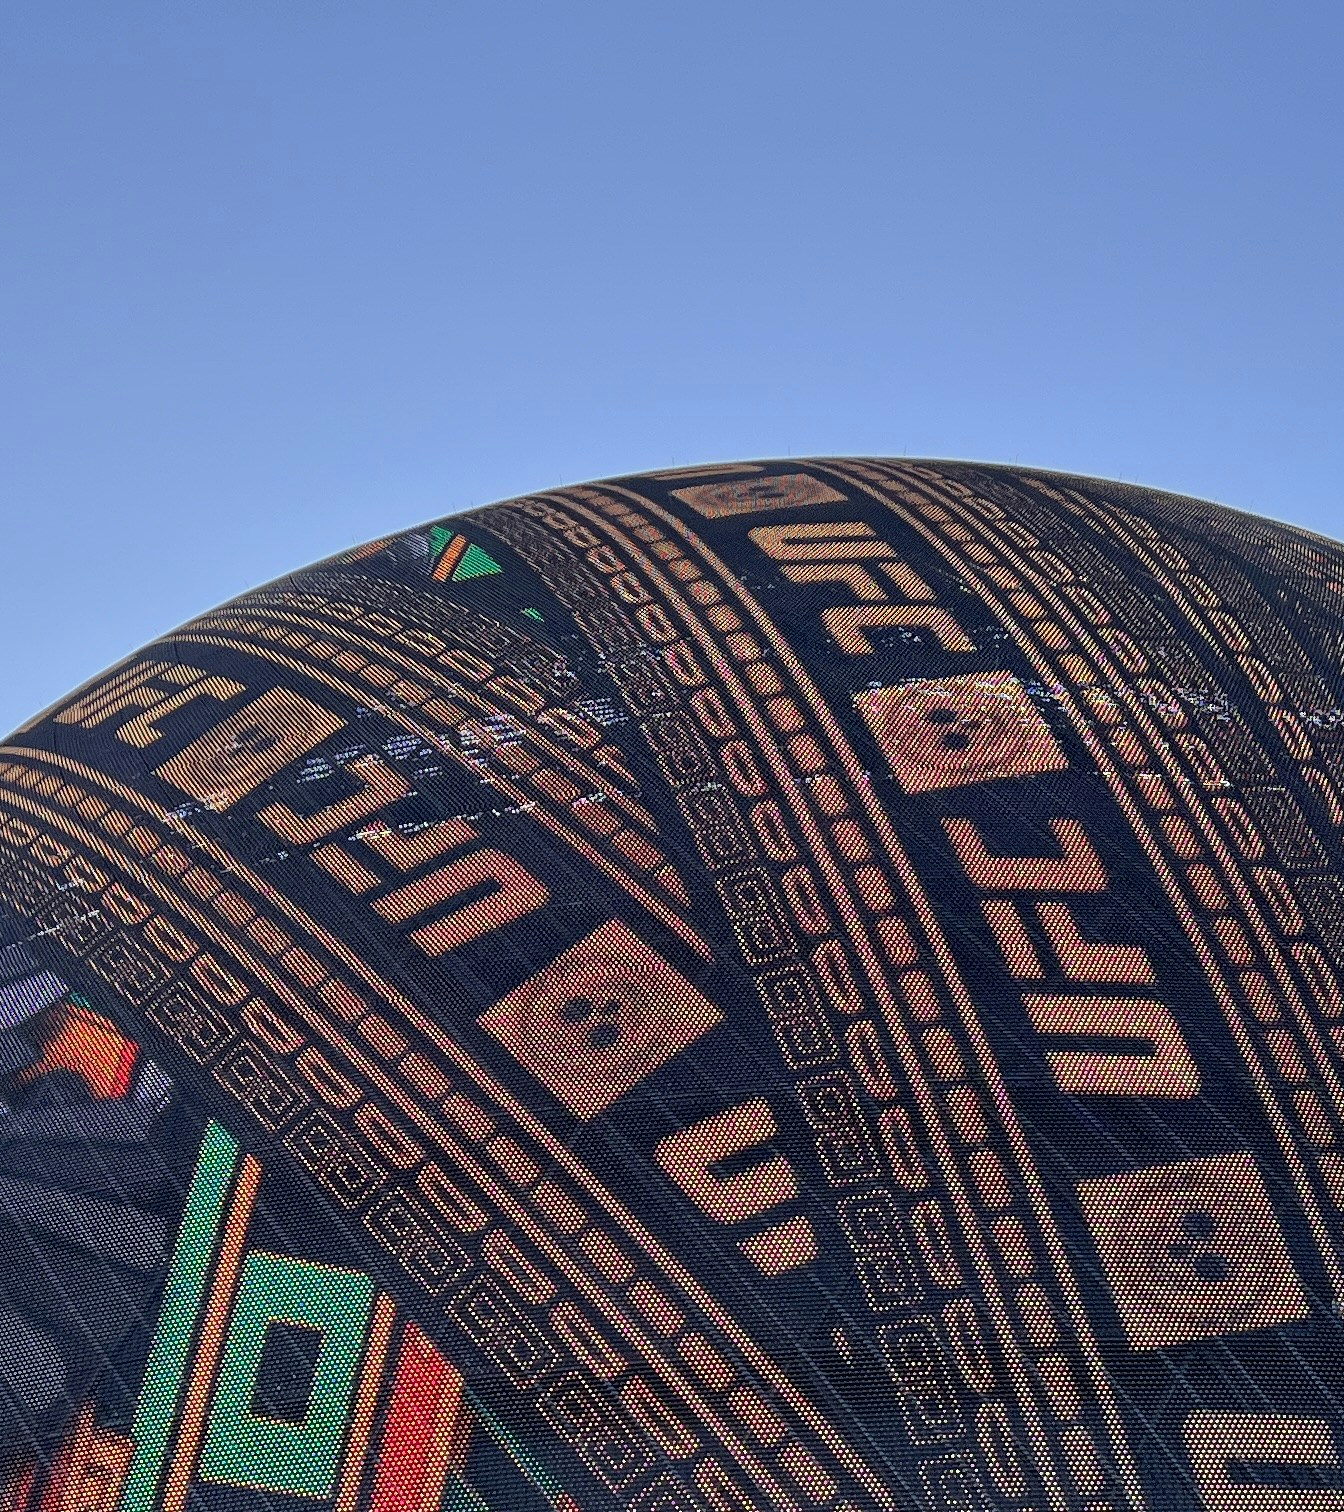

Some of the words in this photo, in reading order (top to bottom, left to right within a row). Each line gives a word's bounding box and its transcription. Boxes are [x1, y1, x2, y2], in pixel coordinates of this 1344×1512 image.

[748, 521, 977, 655] UFC
[258, 754, 550, 957] UFC
[943, 817, 1203, 1101] UFC
